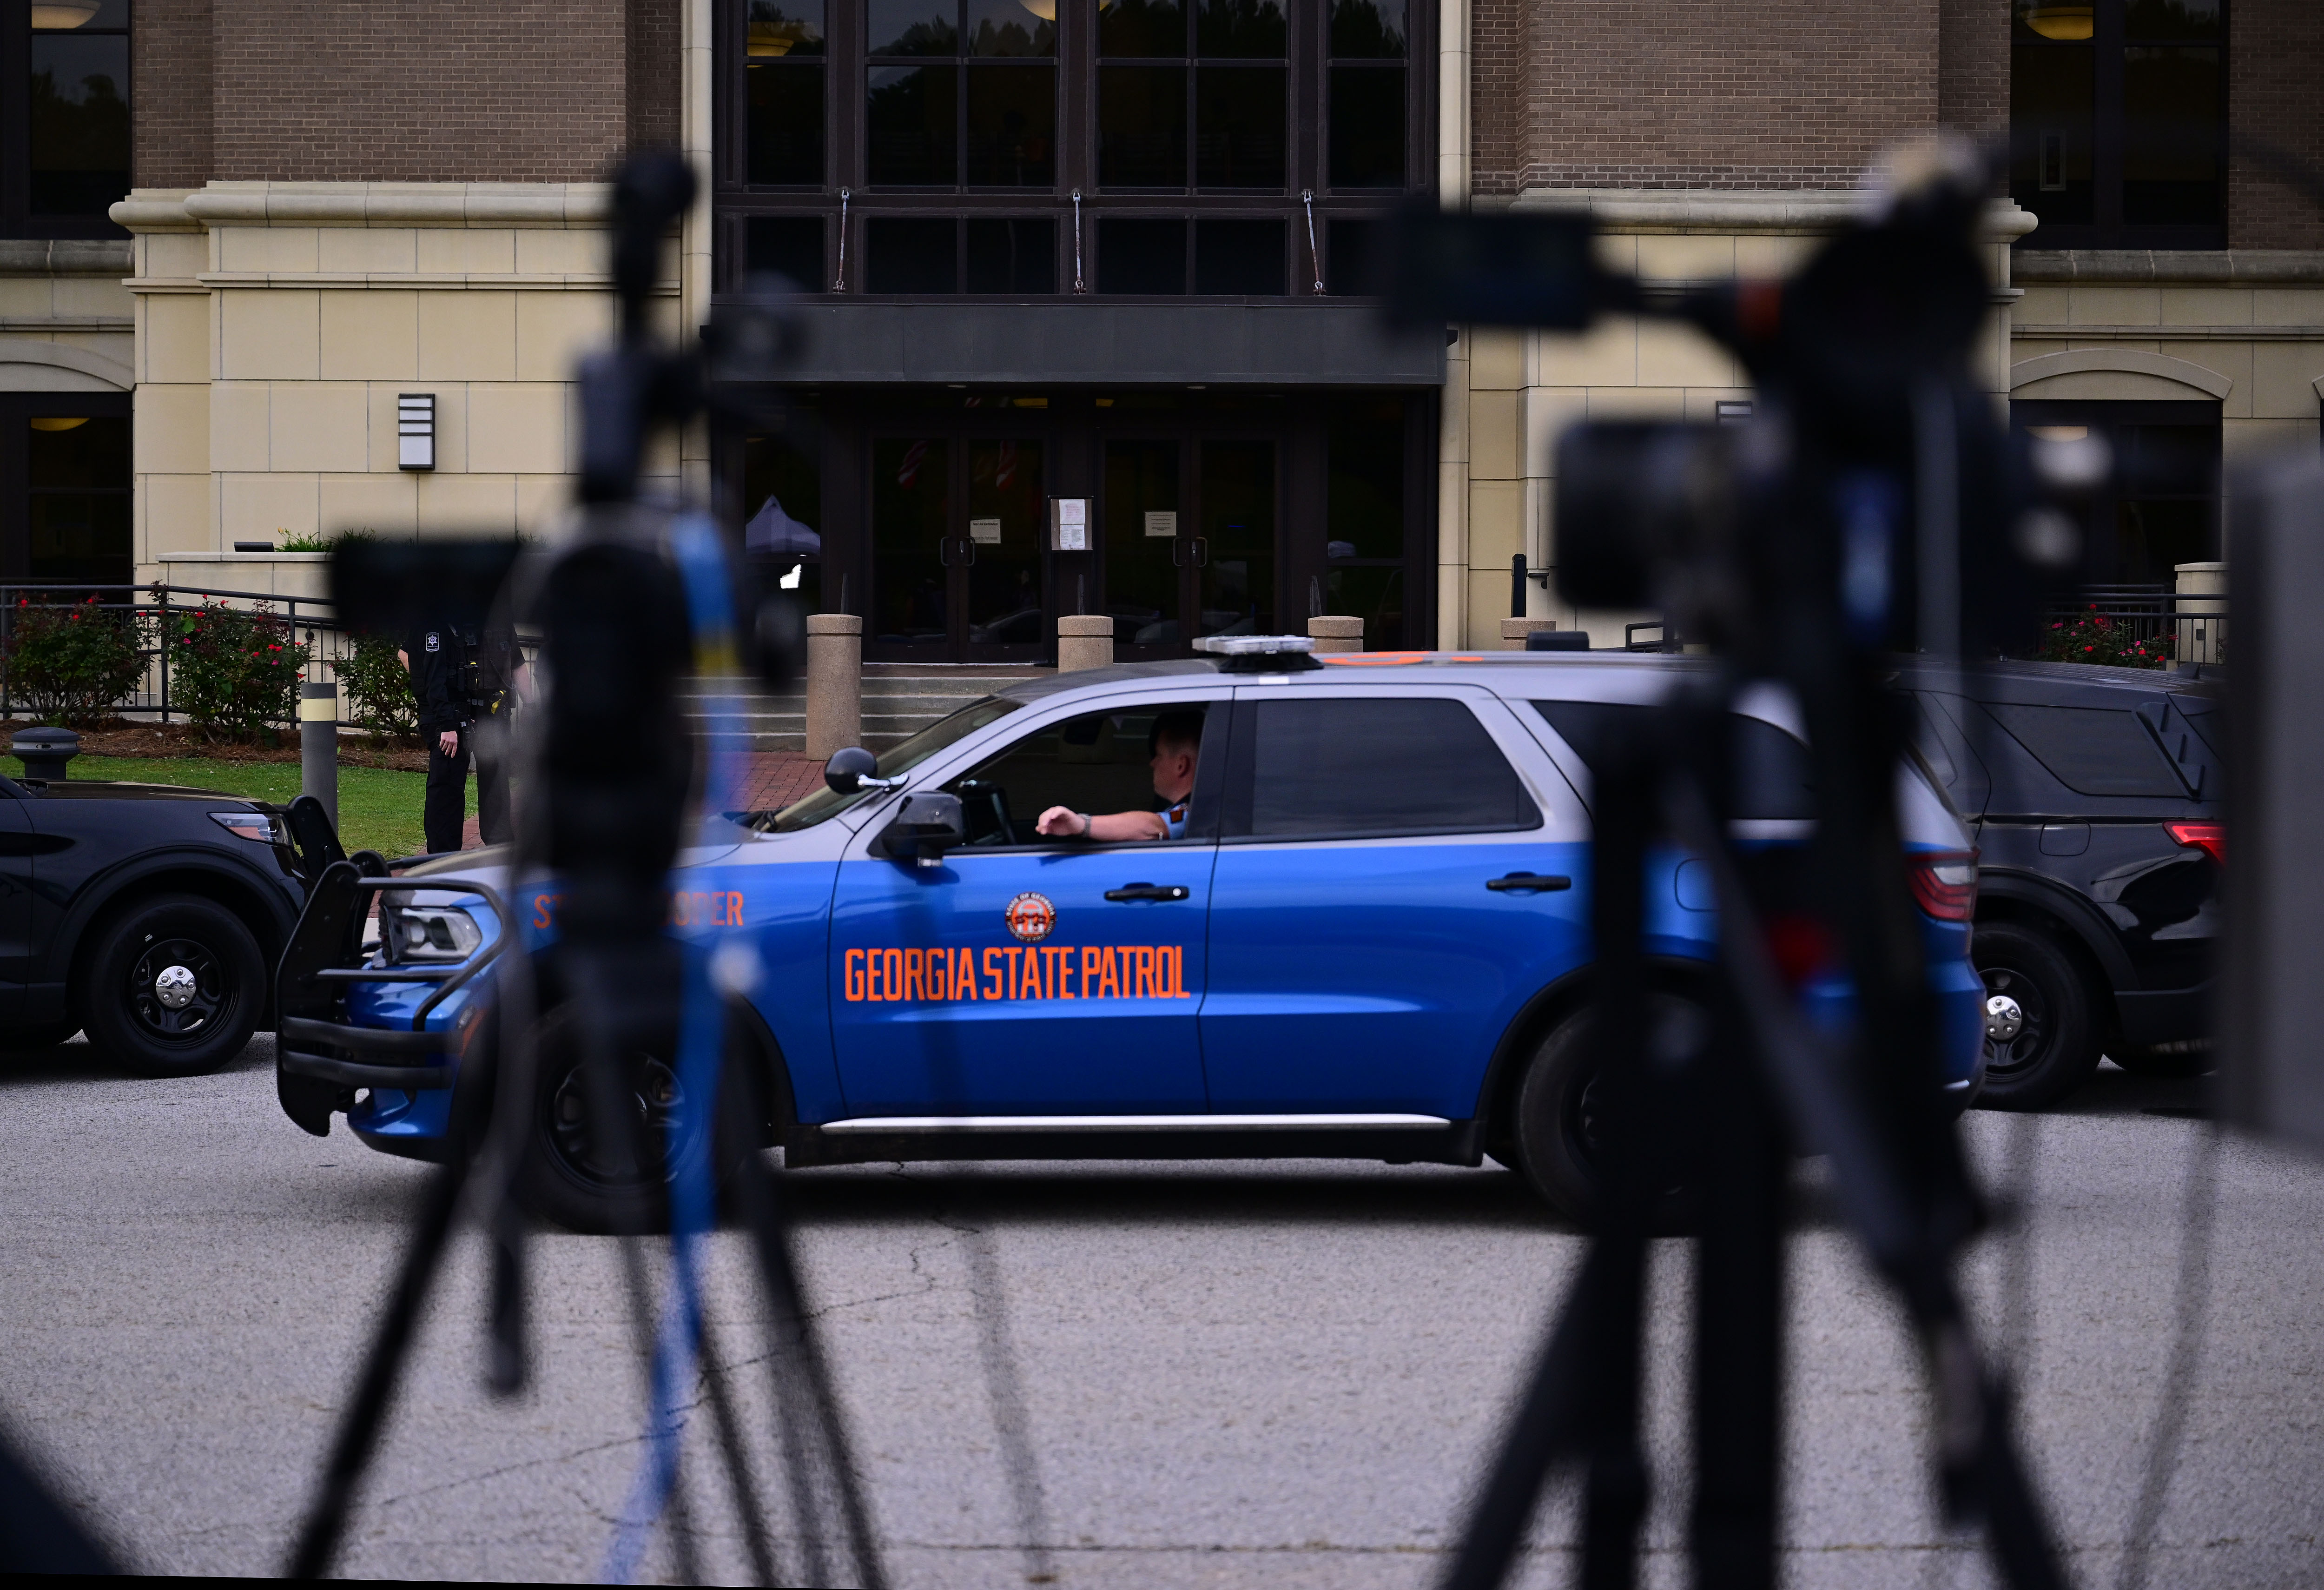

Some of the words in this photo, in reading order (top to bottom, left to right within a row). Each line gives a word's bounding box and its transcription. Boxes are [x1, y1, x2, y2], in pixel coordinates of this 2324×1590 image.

[845, 947, 977, 1001] GEORGIA
[983, 947, 1075, 1000] STATE
[1082, 946, 1190, 999] PATROL
